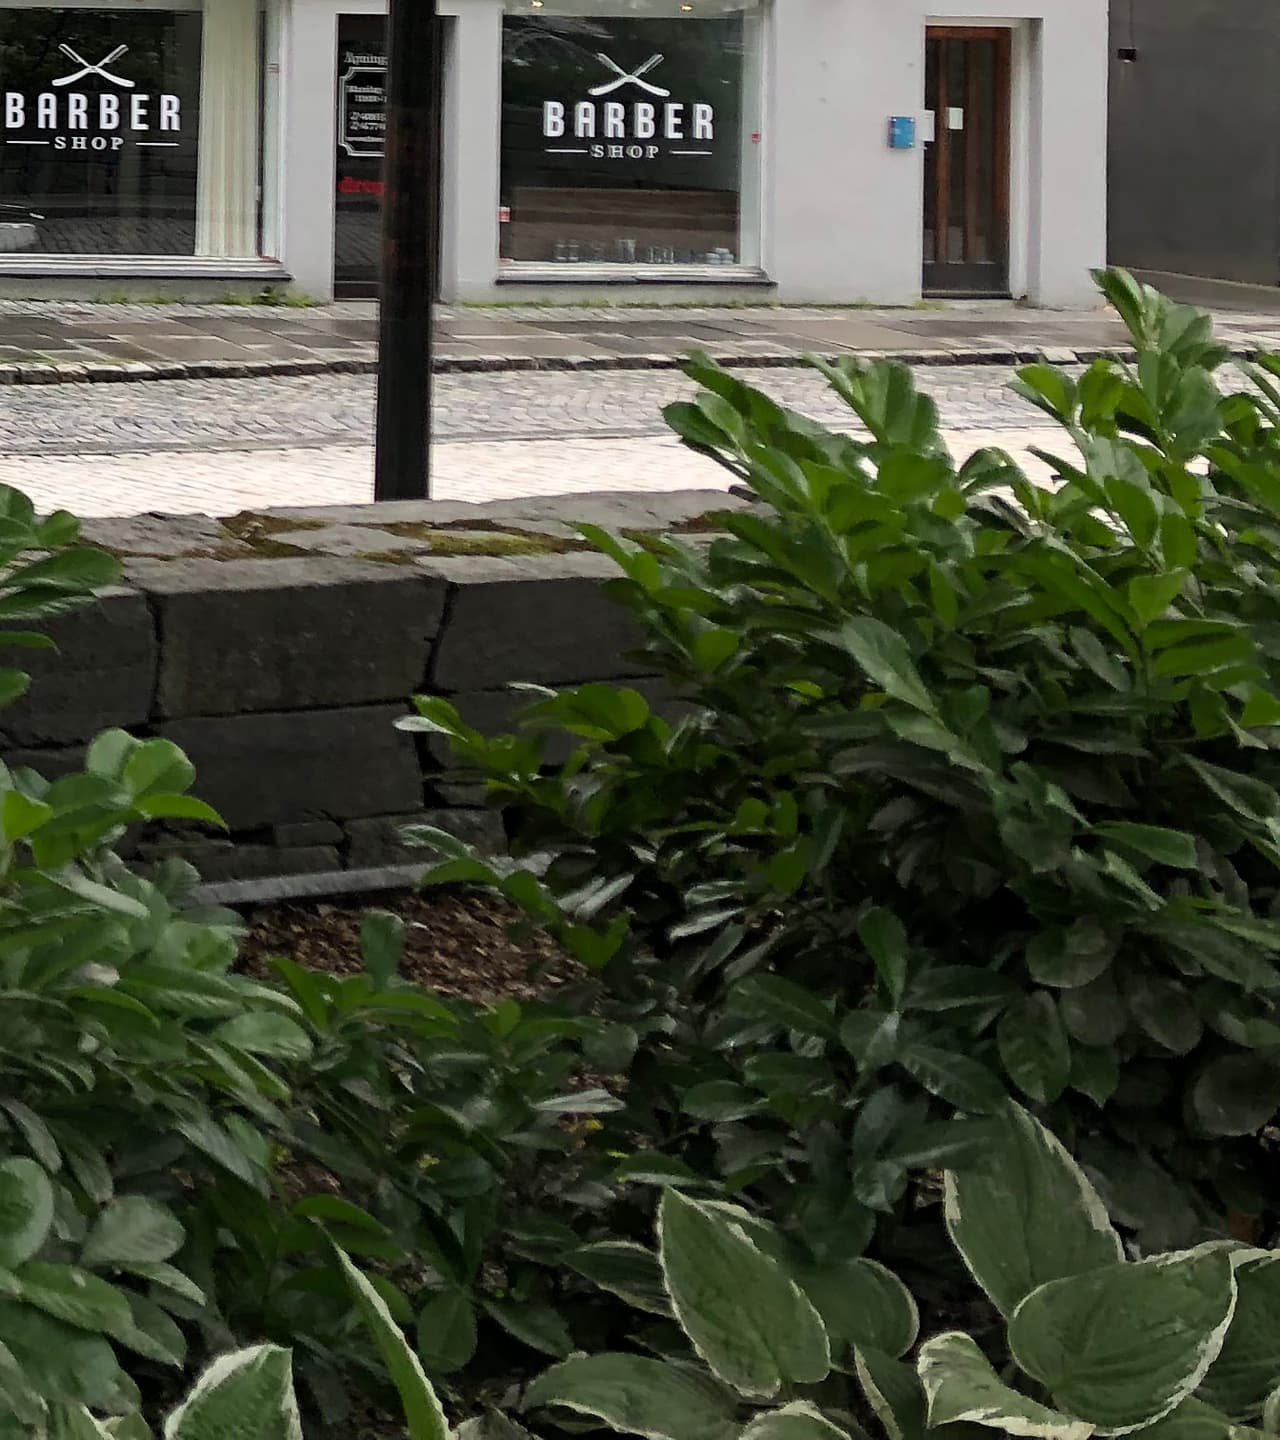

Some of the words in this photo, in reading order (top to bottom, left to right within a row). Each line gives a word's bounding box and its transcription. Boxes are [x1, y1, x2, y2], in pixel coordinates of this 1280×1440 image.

[5, 92, 181, 131] BARBER
[543, 101, 714, 140] BARBER
[54, 136, 124, 150] SHOP
[591, 144, 659, 158] SHOP
